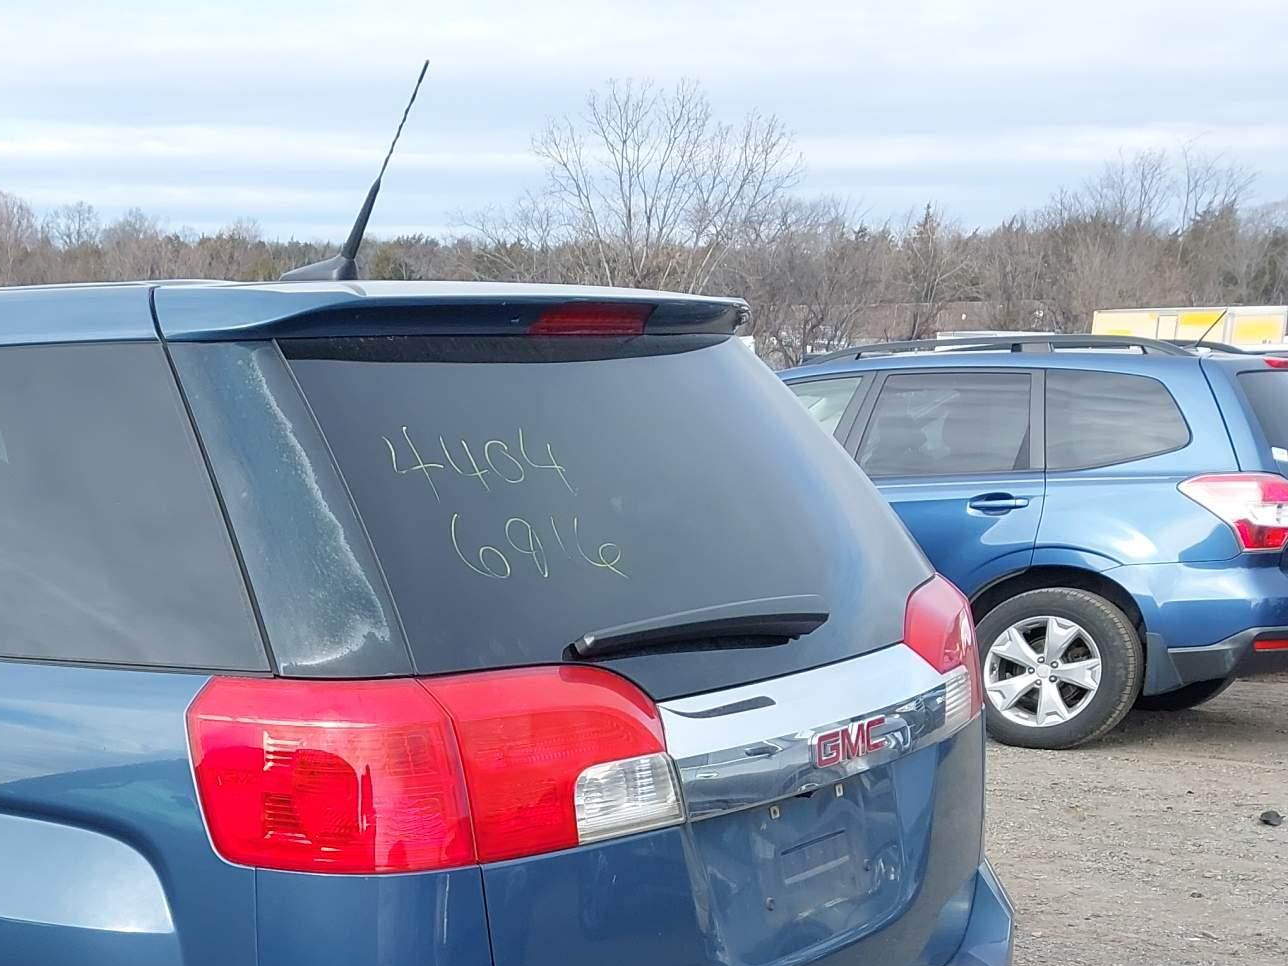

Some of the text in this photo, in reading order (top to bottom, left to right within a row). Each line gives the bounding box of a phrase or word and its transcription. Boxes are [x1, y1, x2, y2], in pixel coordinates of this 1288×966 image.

[381, 425, 577, 503] 4404
[451, 512, 630, 579] 6916
[815, 714, 888, 768] GMC
